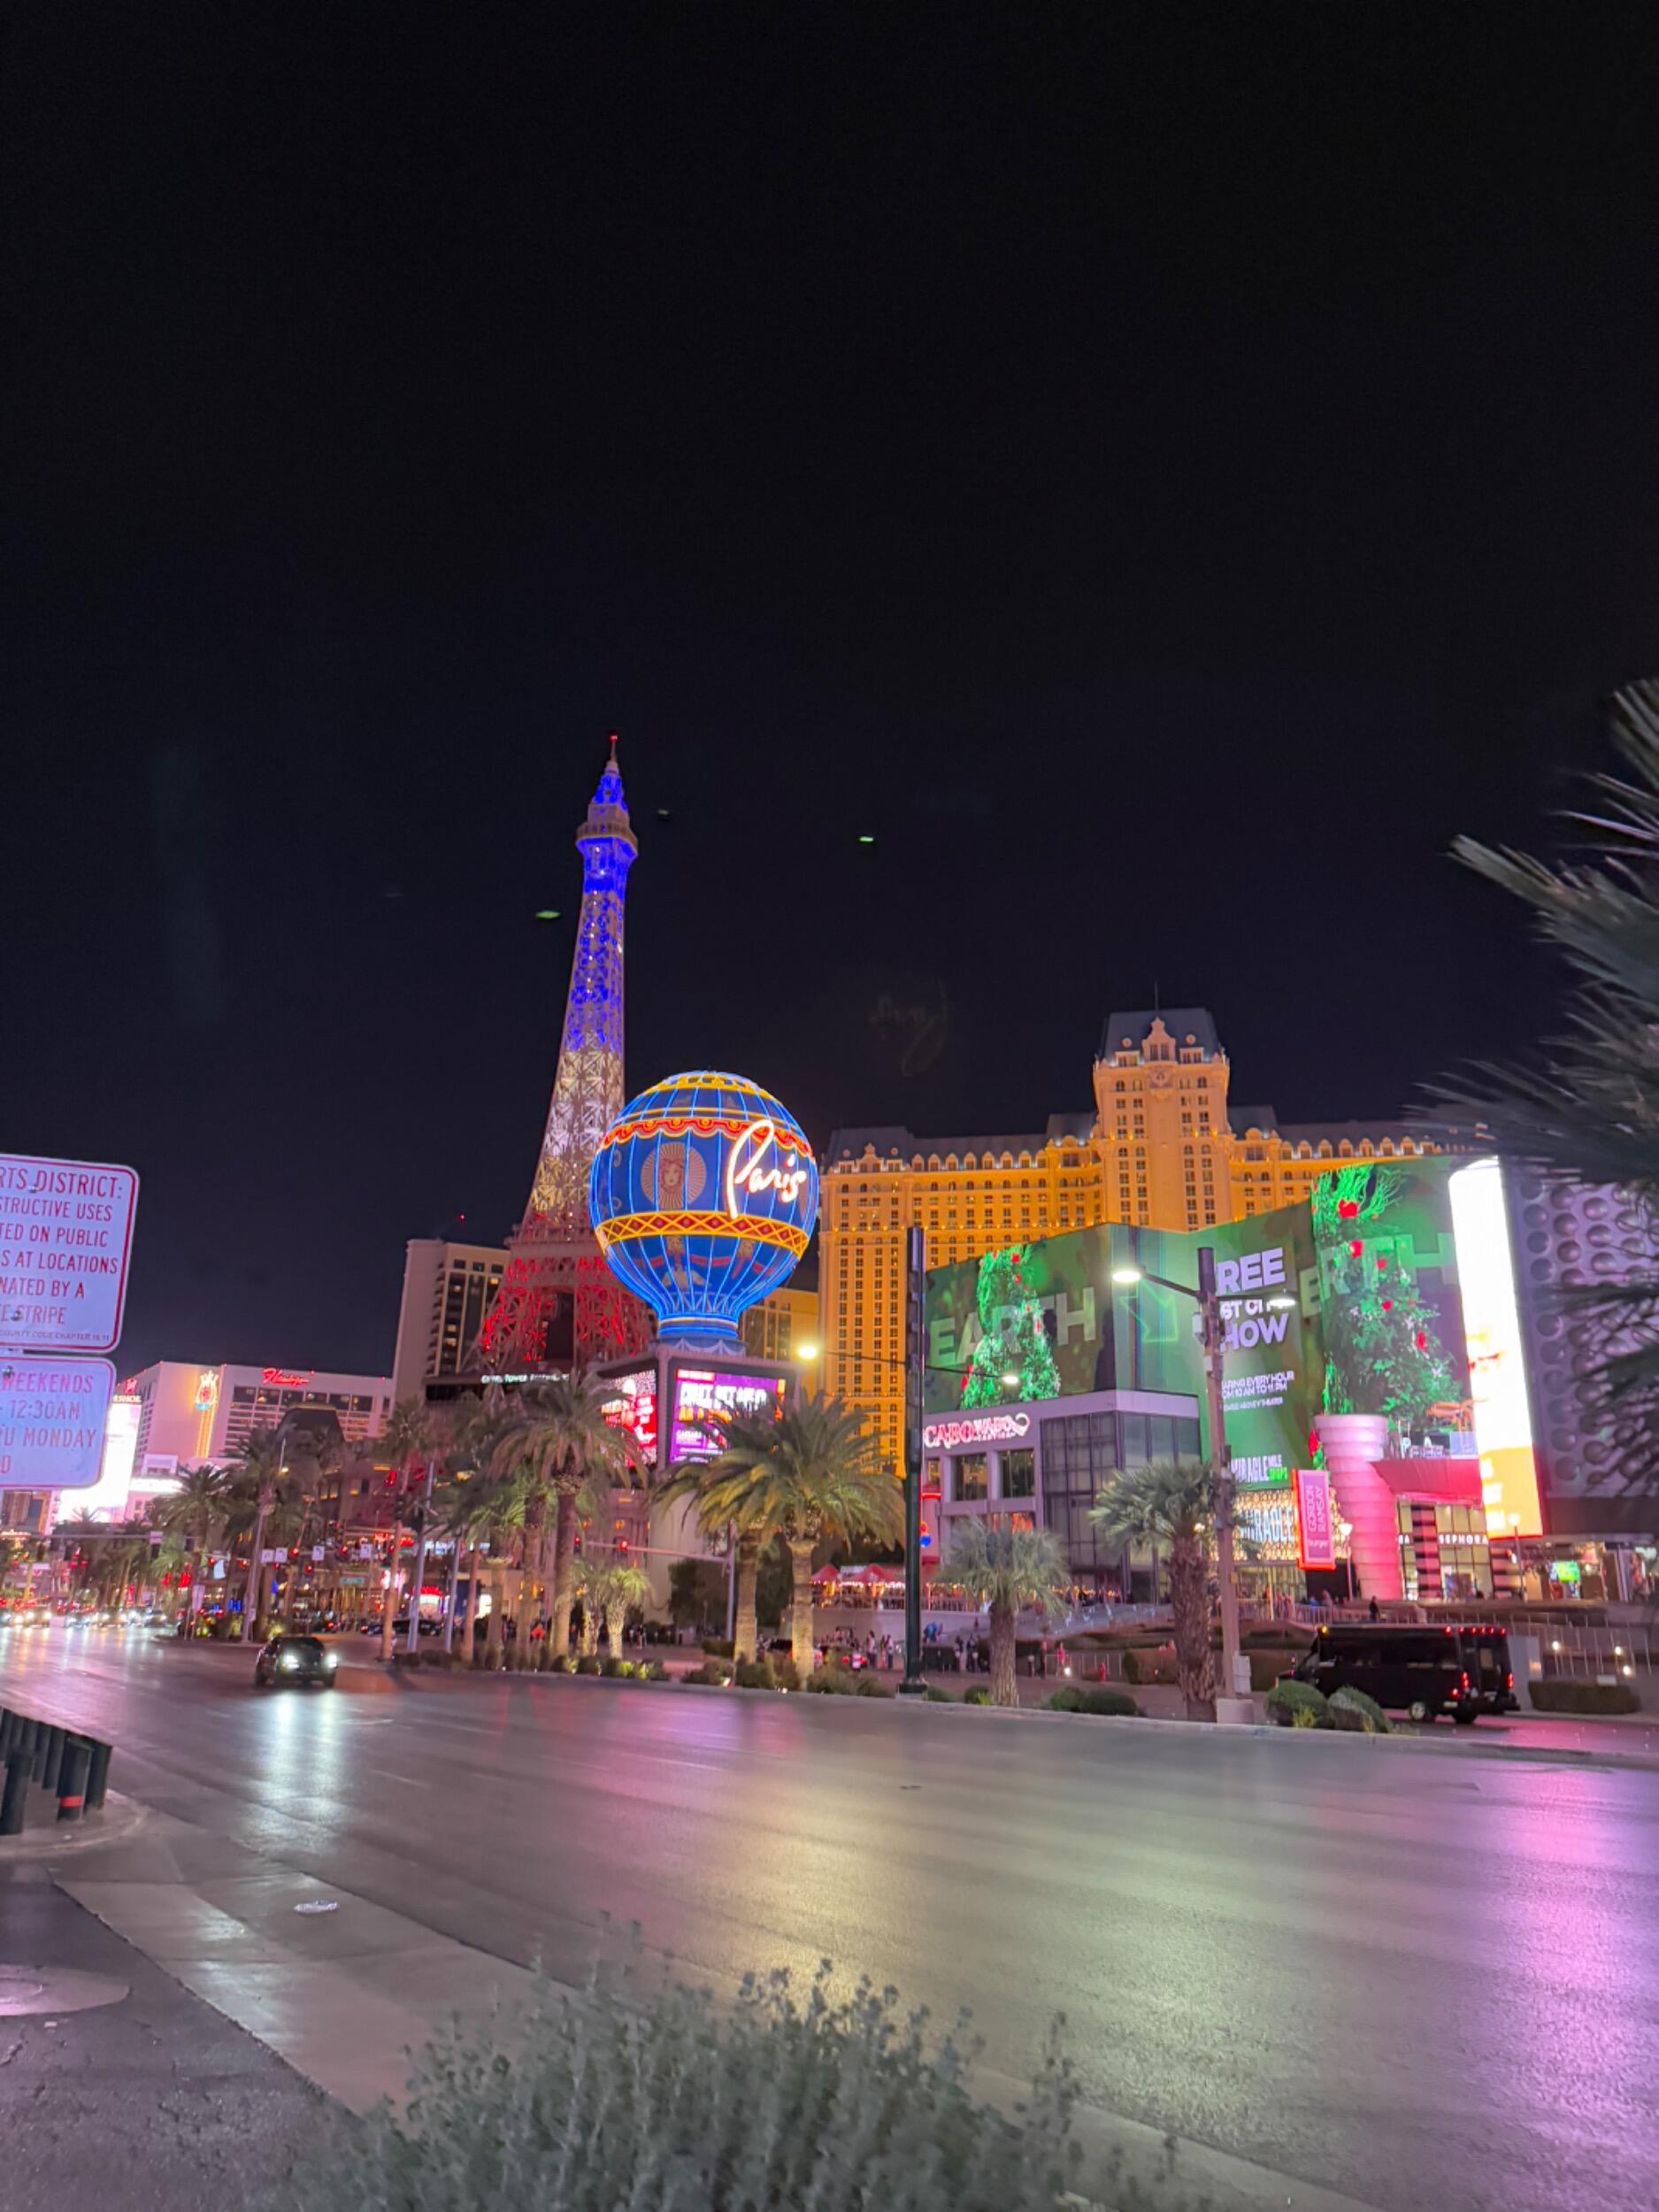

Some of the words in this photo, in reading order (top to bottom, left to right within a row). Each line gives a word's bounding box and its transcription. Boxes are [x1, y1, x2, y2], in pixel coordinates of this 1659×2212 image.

[726, 1118, 807, 1220] Paris
[35, 1170, 122, 1199] DISTRICT:
[76, 1202, 112, 1222] USES
[29, 1225, 50, 1243] ON
[56, 1226, 108, 1248] PUBLIC
[15, 1250, 33, 1268] AT
[38, 1252, 119, 1274] LOCATIONS
[1216, 1247, 1286, 1296] REE
[50, 1279, 70, 1297] BY
[74, 1281, 85, 1299] A
[12, 1305, 66, 1325] STRIPE
[1219, 1312, 1289, 1353] HOW
[2, 1371, 94, 1394] WEEKENDS
[10, 1400, 81, 1419] 12:30AM
[23, 1427, 96, 1448] MONDAY
[924, 1420, 974, 1449] CABO
[1305, 1485, 1317, 1531] GORDON
[1317, 1486, 1327, 1532] RAMSAY
[1439, 1534, 1488, 1545] SEPHORA
